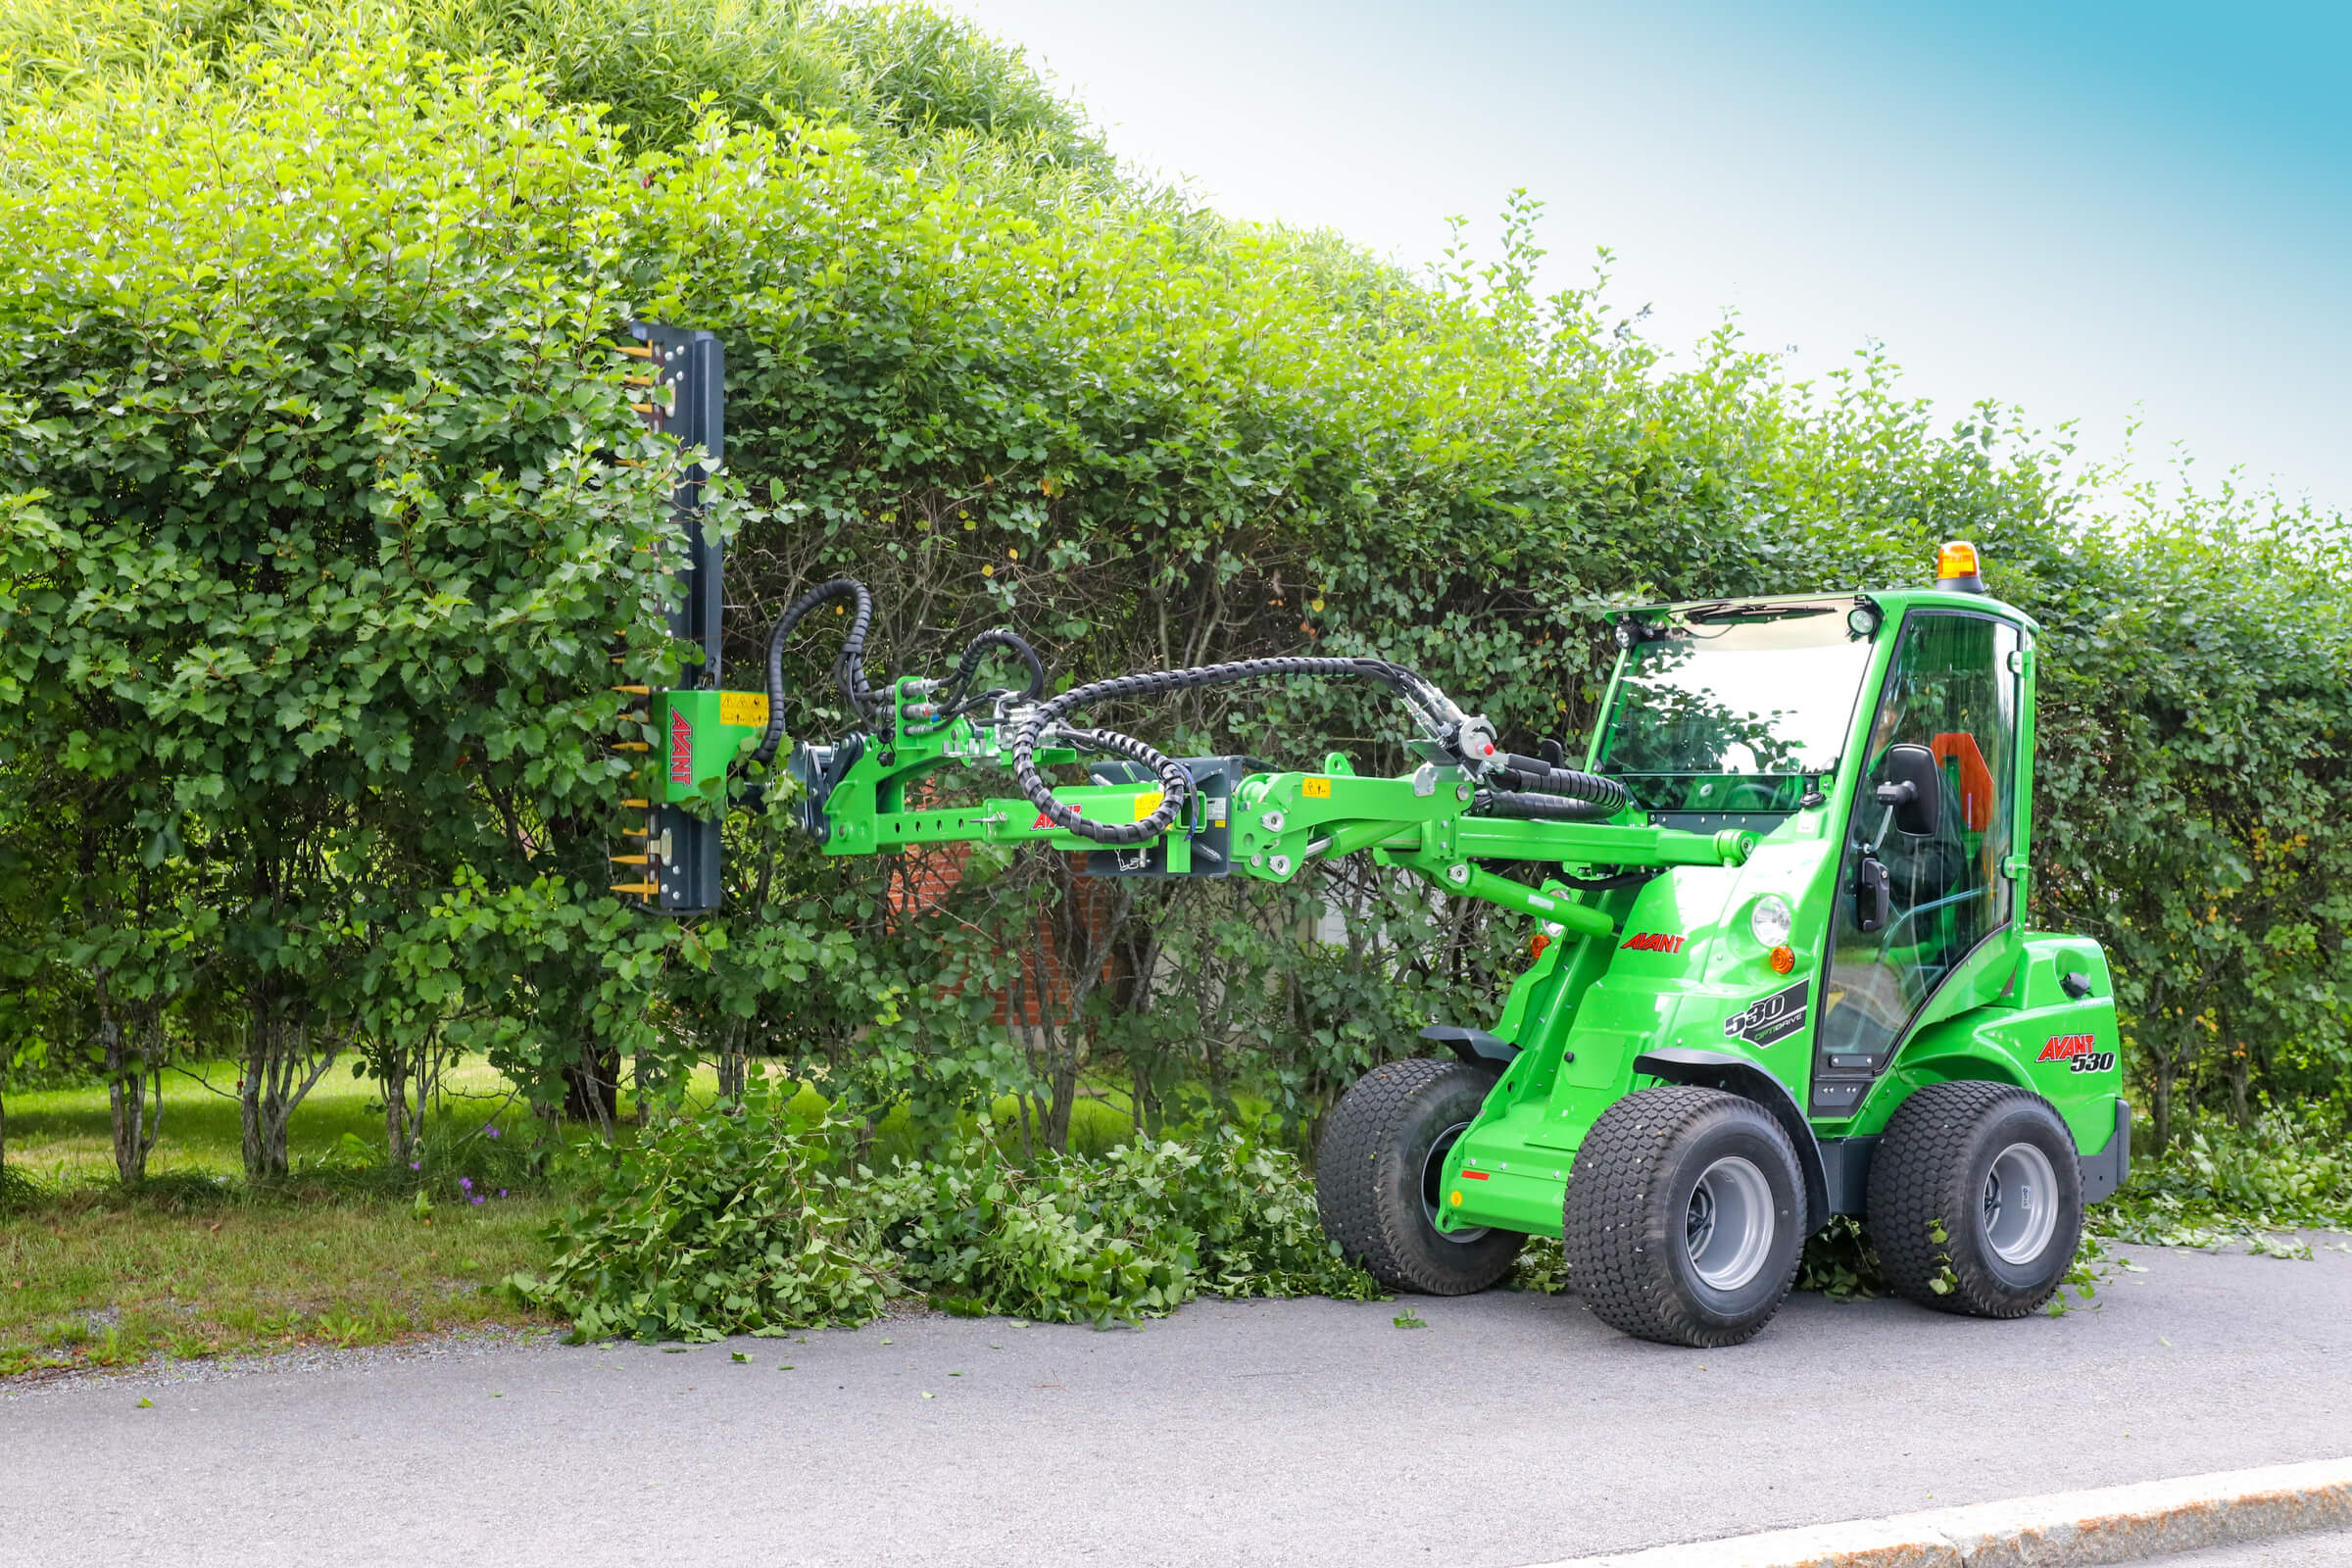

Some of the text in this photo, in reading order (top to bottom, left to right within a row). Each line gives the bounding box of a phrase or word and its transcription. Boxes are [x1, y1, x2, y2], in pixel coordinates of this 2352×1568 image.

[670, 705, 693, 787] AVANT
[1620, 932, 1686, 955] AVANT
[1724, 994, 1785, 1037] 530
[2034, 1033, 2095, 1063] AVANT
[2070, 1052, 2115, 1074] 530
